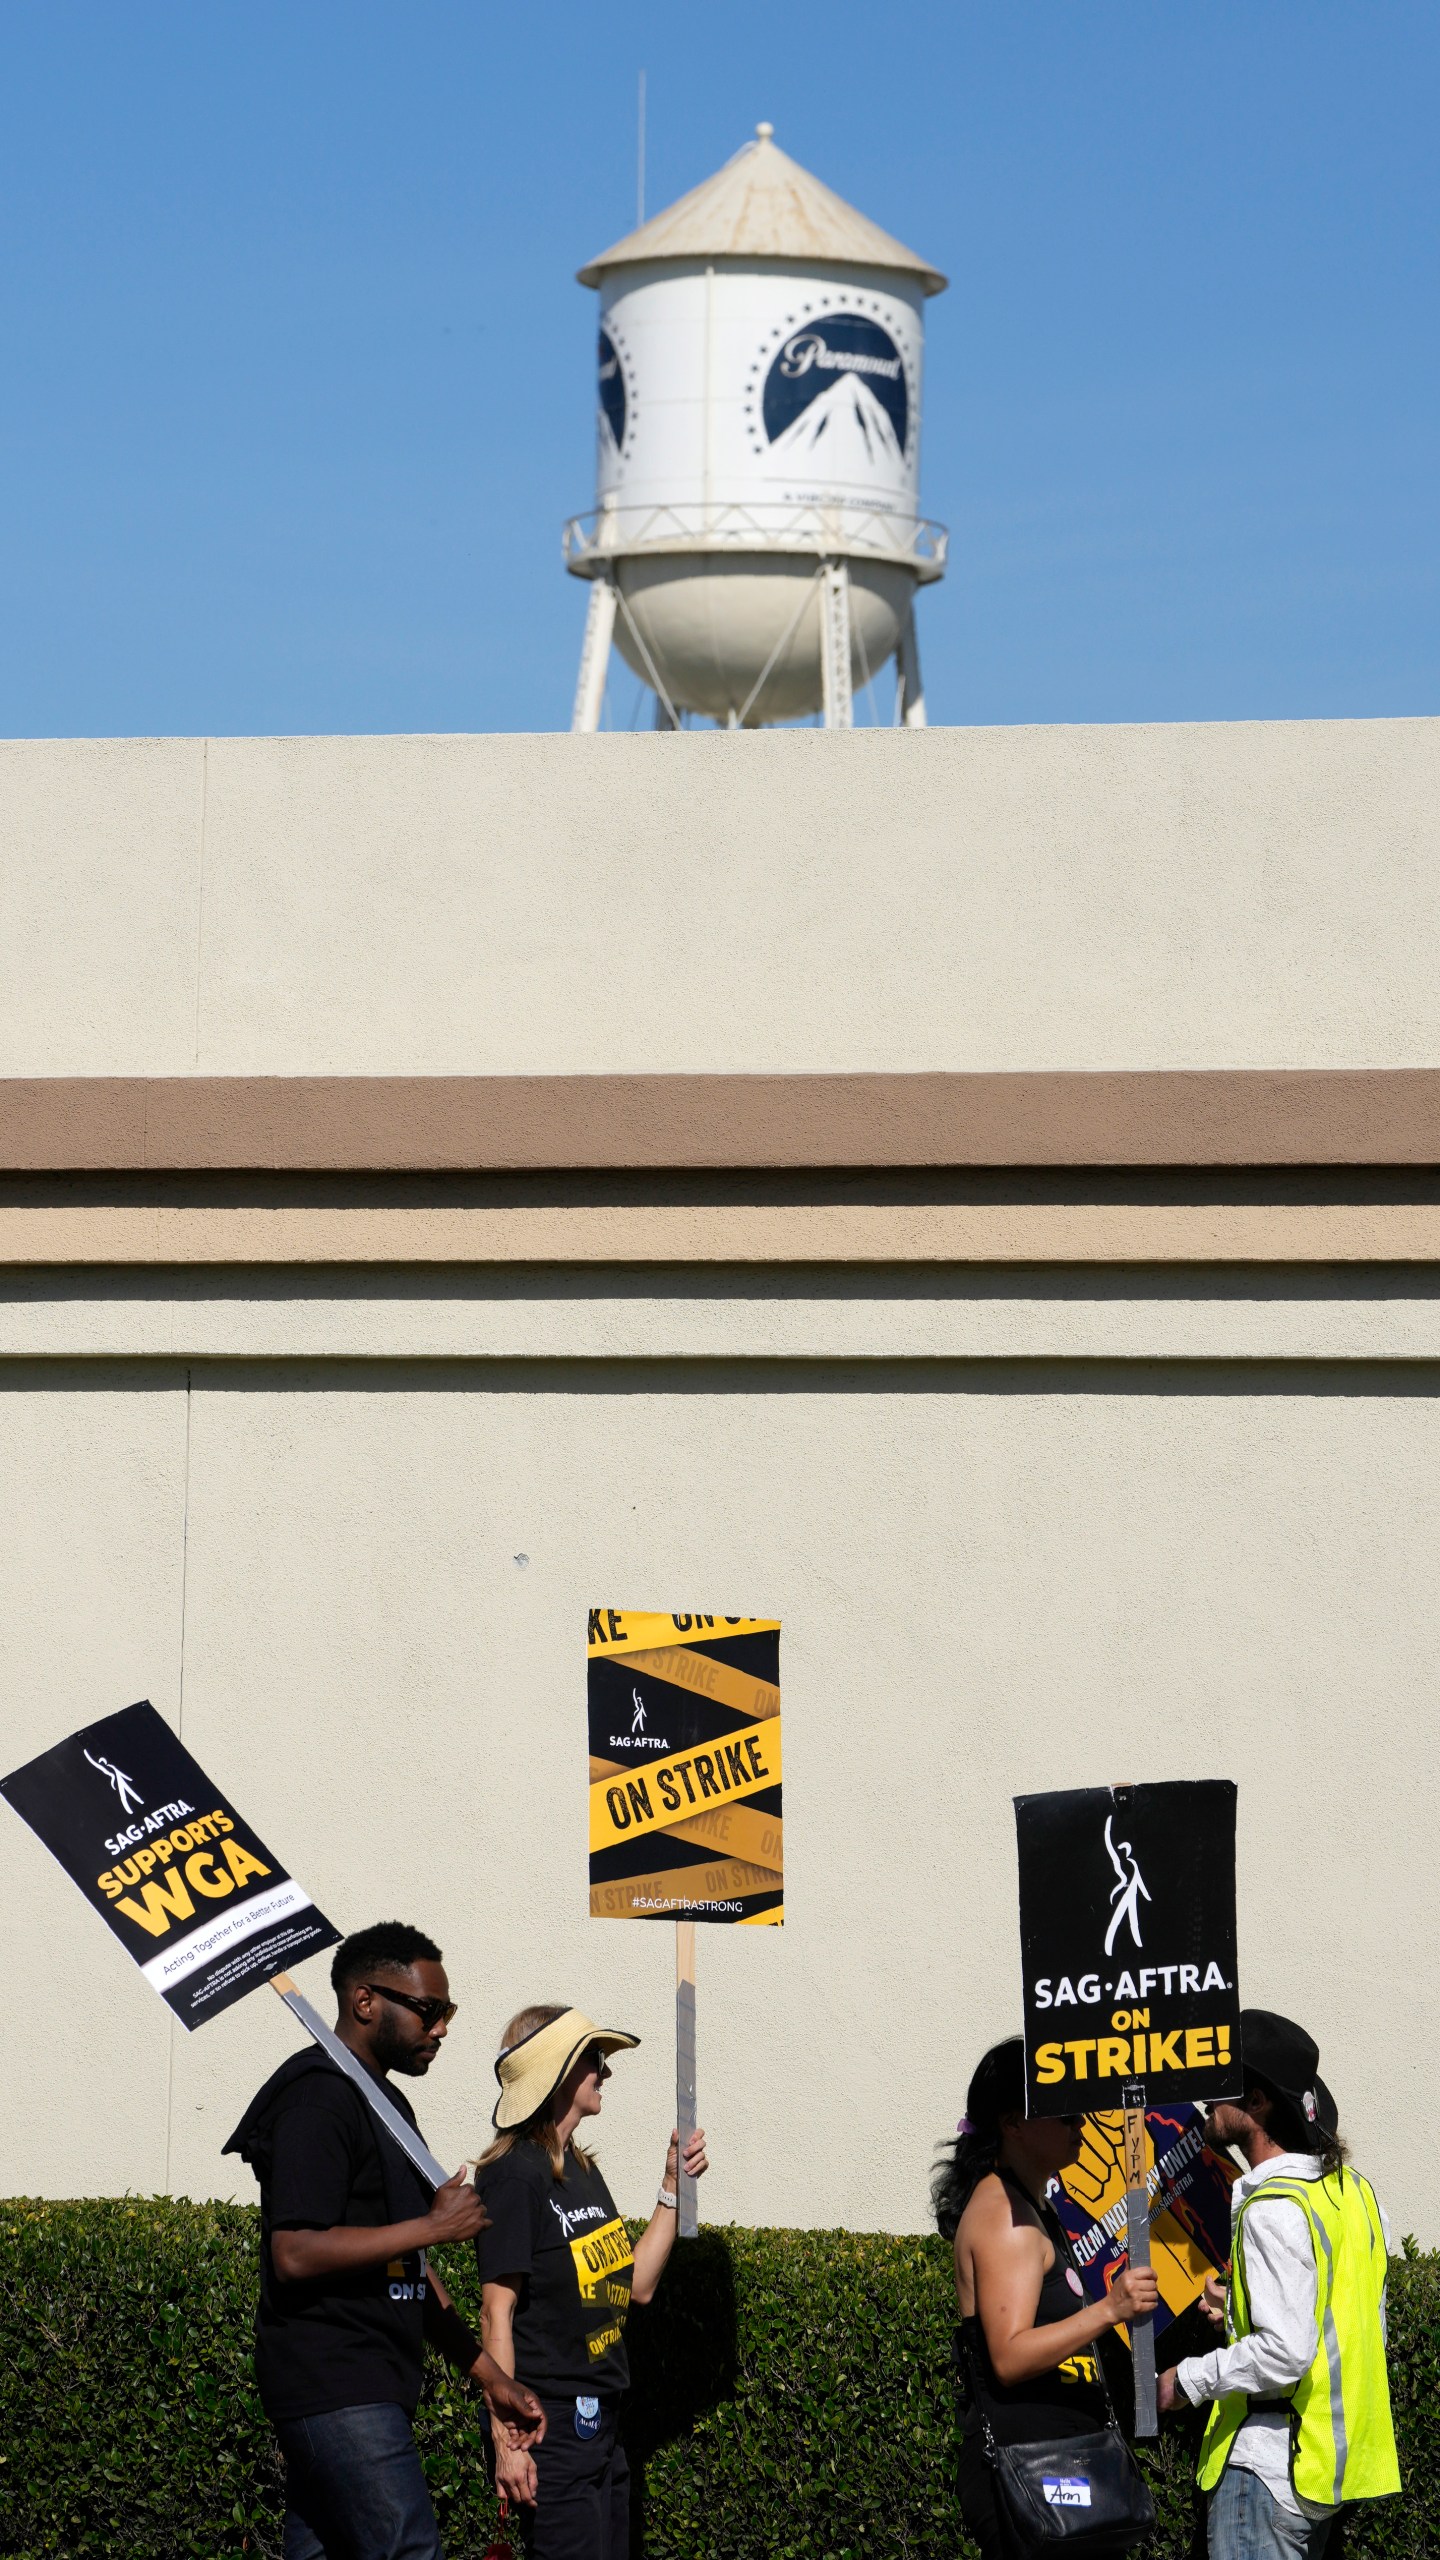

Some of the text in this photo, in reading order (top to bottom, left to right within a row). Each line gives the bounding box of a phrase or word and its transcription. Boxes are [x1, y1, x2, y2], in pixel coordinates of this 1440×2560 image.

[780, 333, 901, 379] Paramount
[606, 1734, 770, 1830] ON STRIKE
[97, 1810, 235, 1899] SUPPORTS
[114, 1838, 272, 1938] WGA
[163, 1894, 295, 1975] Acting Together for a Better Future
[632, 1896, 743, 1912] #SAGAFTRASTRONG
[1111, 2007, 1150, 2031] ON
[1034, 2025, 1232, 2084] STRIKE!
[1072, 2223, 1107, 2267] FILM
[1159, 2127, 1207, 2179] UNITE!
[388, 2283, 415, 2300] ON
